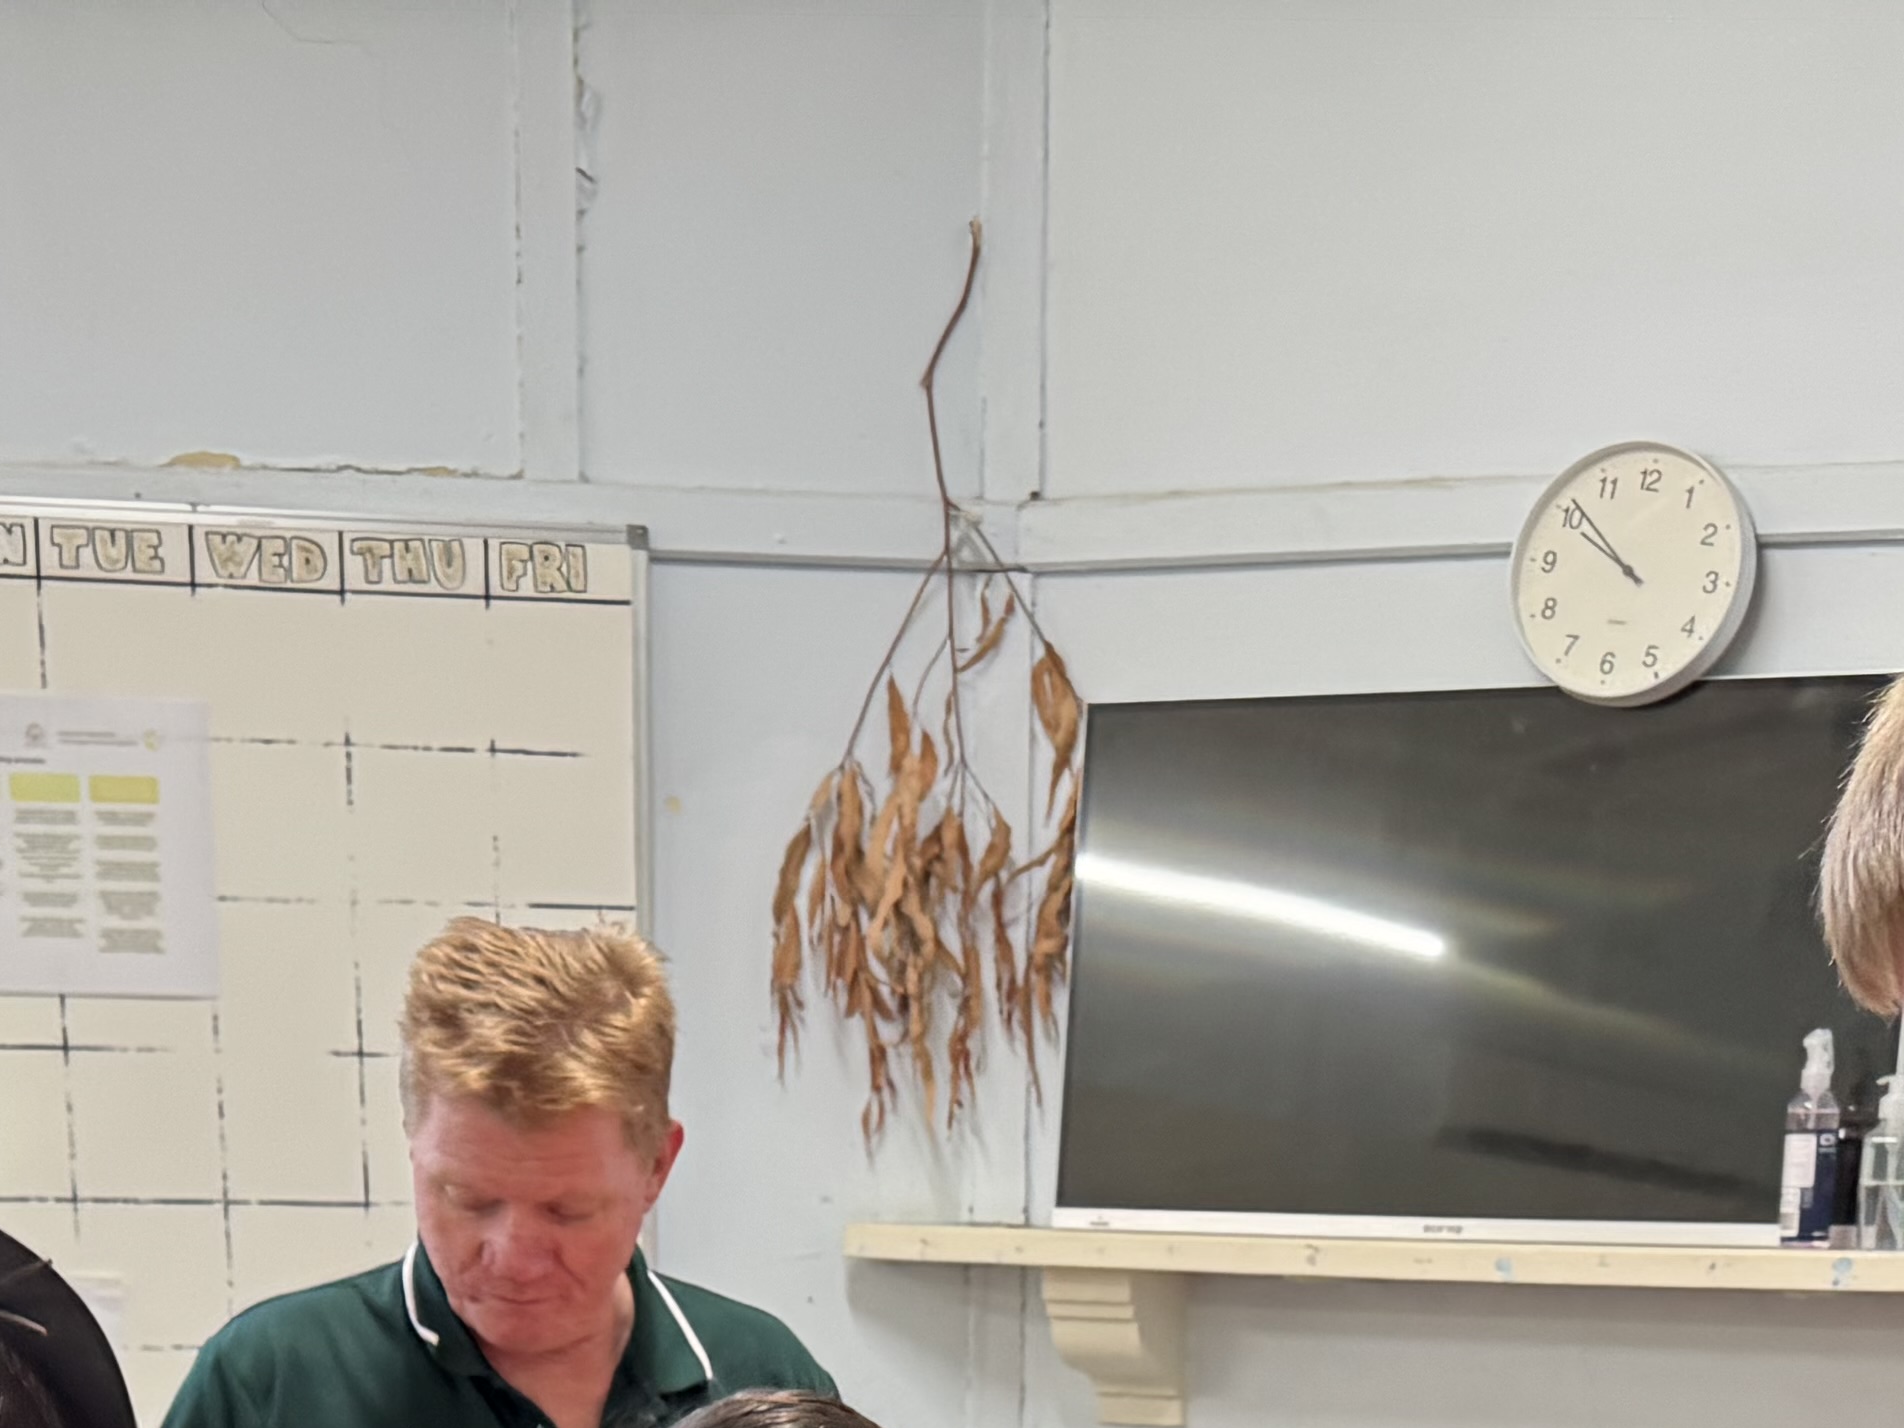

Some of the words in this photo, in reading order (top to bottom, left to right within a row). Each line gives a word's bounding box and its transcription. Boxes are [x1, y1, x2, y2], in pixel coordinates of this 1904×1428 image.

[1598, 477, 1618, 499] 11
[1639, 468, 1663, 492] 12
[1684, 486, 1695, 509] 1
[1561, 503, 1584, 530] 10
[1699, 522, 1718, 547] 2
[50, 524, 165, 574] TUE
[204, 530, 327, 583] WED
[350, 537, 465, 590] THU
[499, 541, 588, 593] FRI
[1541, 550, 1558, 573] 9
[1702, 571, 1719, 594] 3
[1541, 597, 1558, 620] 8
[1680, 615, 1696, 638] 4
[1563, 634, 1580, 657] 7
[1642, 645, 1660, 668] 5
[1599, 652, 1616, 675] 6
